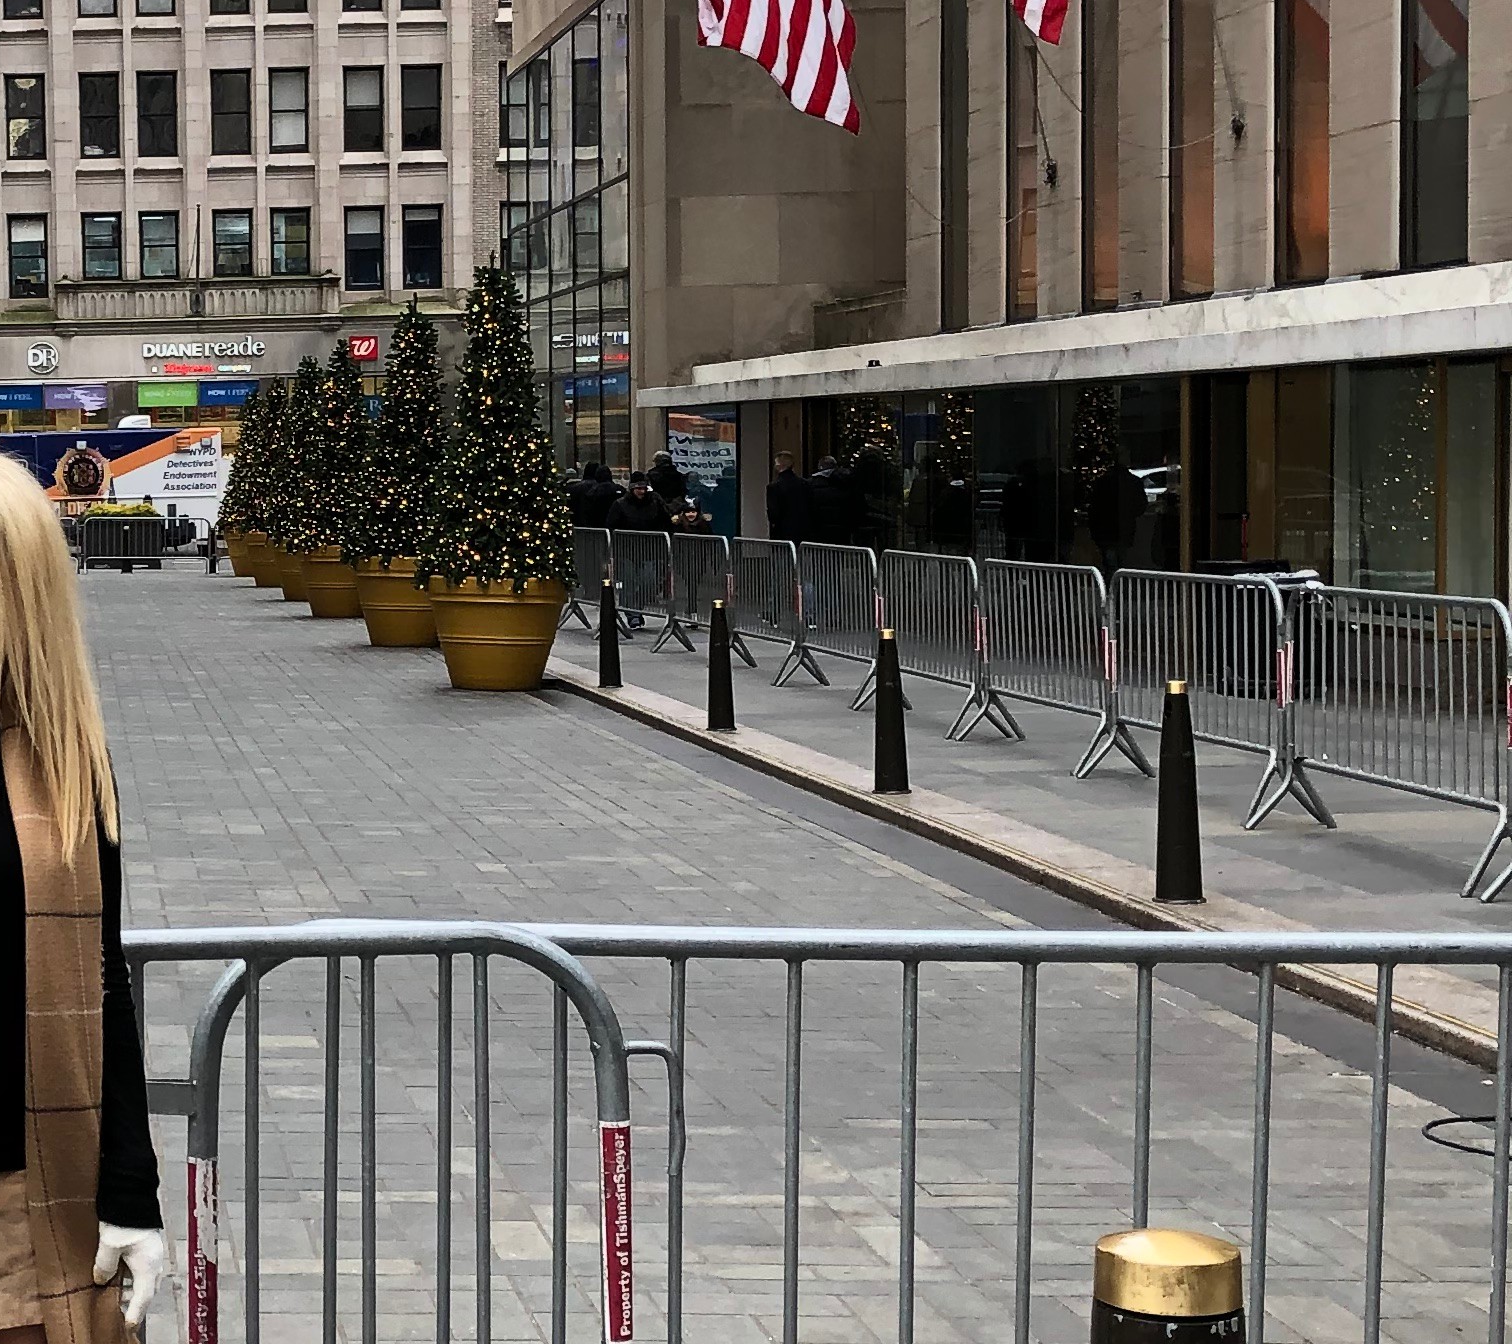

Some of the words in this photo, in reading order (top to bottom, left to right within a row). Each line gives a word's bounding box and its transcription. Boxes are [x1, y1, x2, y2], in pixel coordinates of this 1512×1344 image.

[188, 447, 216, 456] NYPD
[163, 470, 218, 480] Endowment
[163, 482, 218, 492] Association
[619, 1250, 631, 1266] of
[618, 1270, 632, 1337] Property
